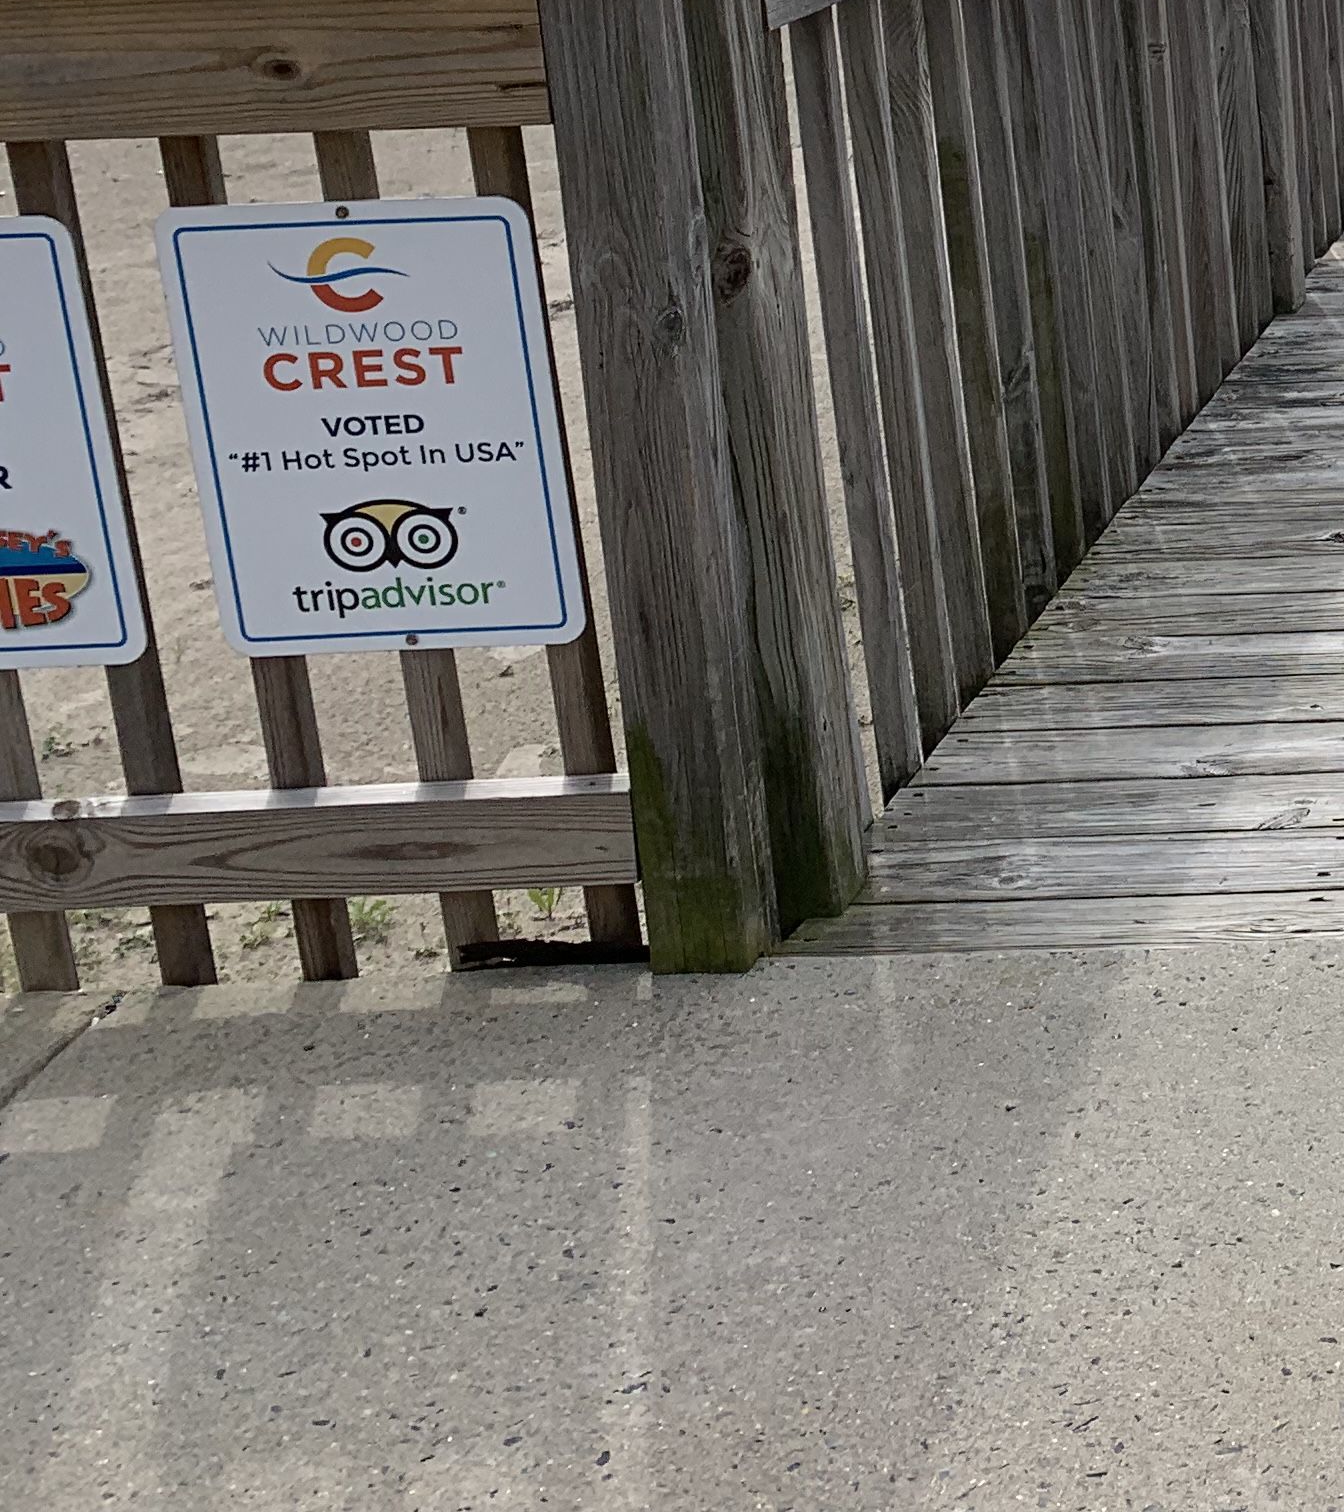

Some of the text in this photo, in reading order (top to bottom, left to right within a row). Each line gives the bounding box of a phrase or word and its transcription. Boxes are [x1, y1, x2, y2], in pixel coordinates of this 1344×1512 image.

[257, 319, 459, 348] WILDWOOD
[262, 346, 464, 393] CREST
[321, 414, 426, 439] VOTED
[282, 448, 336, 472] Hot
[343, 445, 413, 470] Spot
[420, 444, 446, 467] In
[292, 577, 495, 620] tripadvisor
